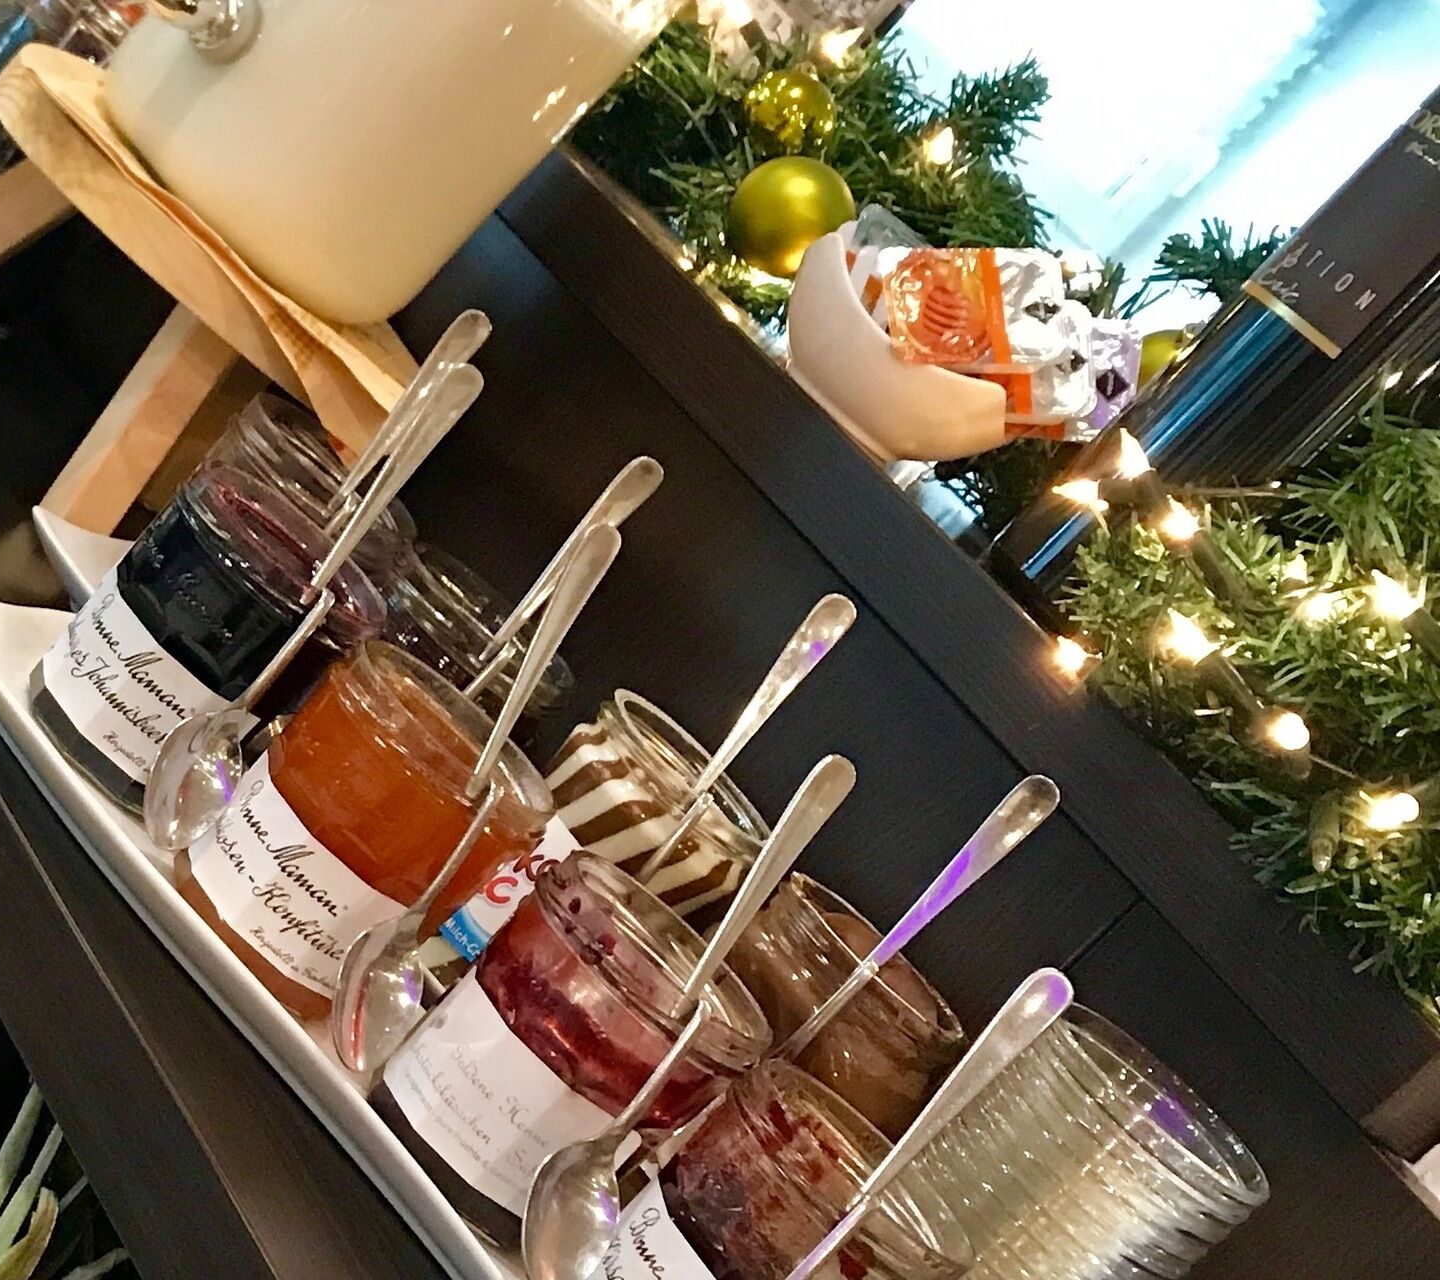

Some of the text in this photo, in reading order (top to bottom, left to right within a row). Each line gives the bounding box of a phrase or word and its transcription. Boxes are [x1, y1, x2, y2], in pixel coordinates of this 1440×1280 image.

[73, 656, 169, 746] Johannisbeer
[118, 648, 190, 721] Maman
[266, 843, 340, 917] Maman
[443, 915, 481, 957] Milch-Cr
[628, 1204, 664, 1280] Bonne
